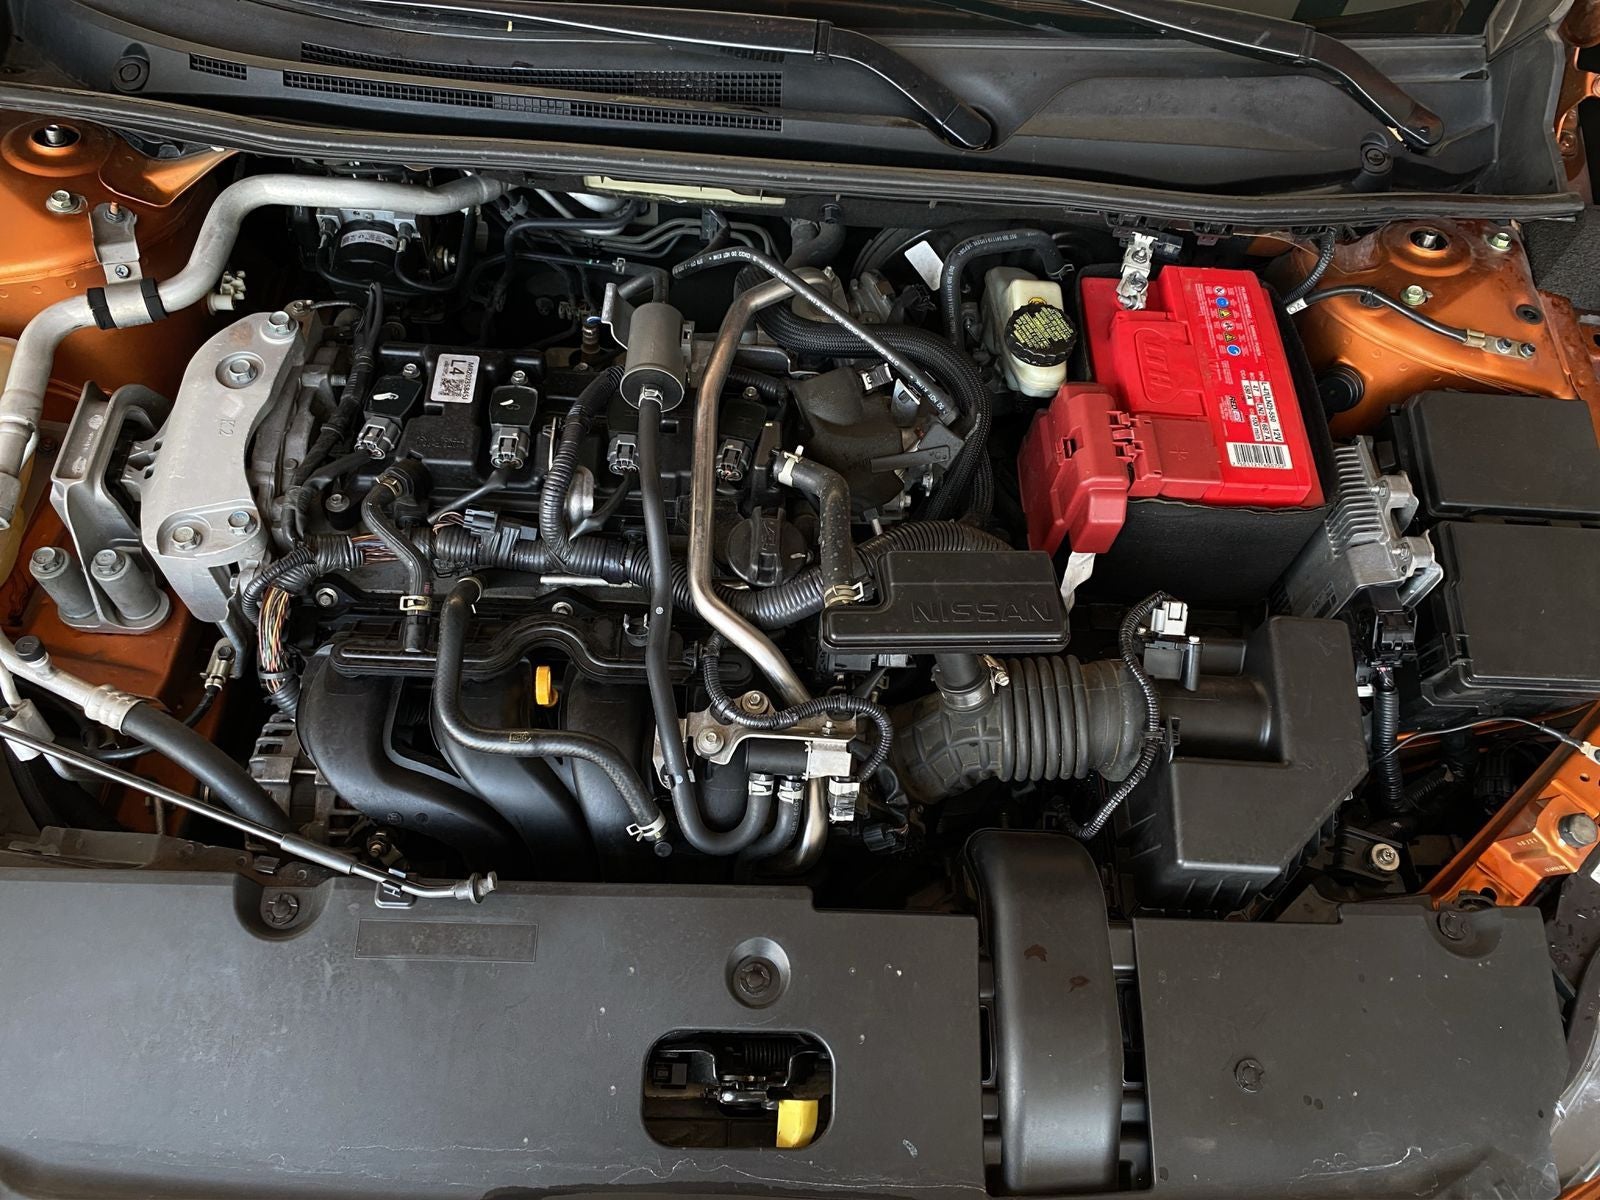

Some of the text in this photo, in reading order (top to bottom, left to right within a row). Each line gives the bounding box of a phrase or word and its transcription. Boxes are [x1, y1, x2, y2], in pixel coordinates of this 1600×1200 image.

[449, 360, 467, 375] L4
[928, 393, 938, 404] NOT
[1273, 428, 1283, 441] 12V
[911, 600, 1054, 623] NISSAN
